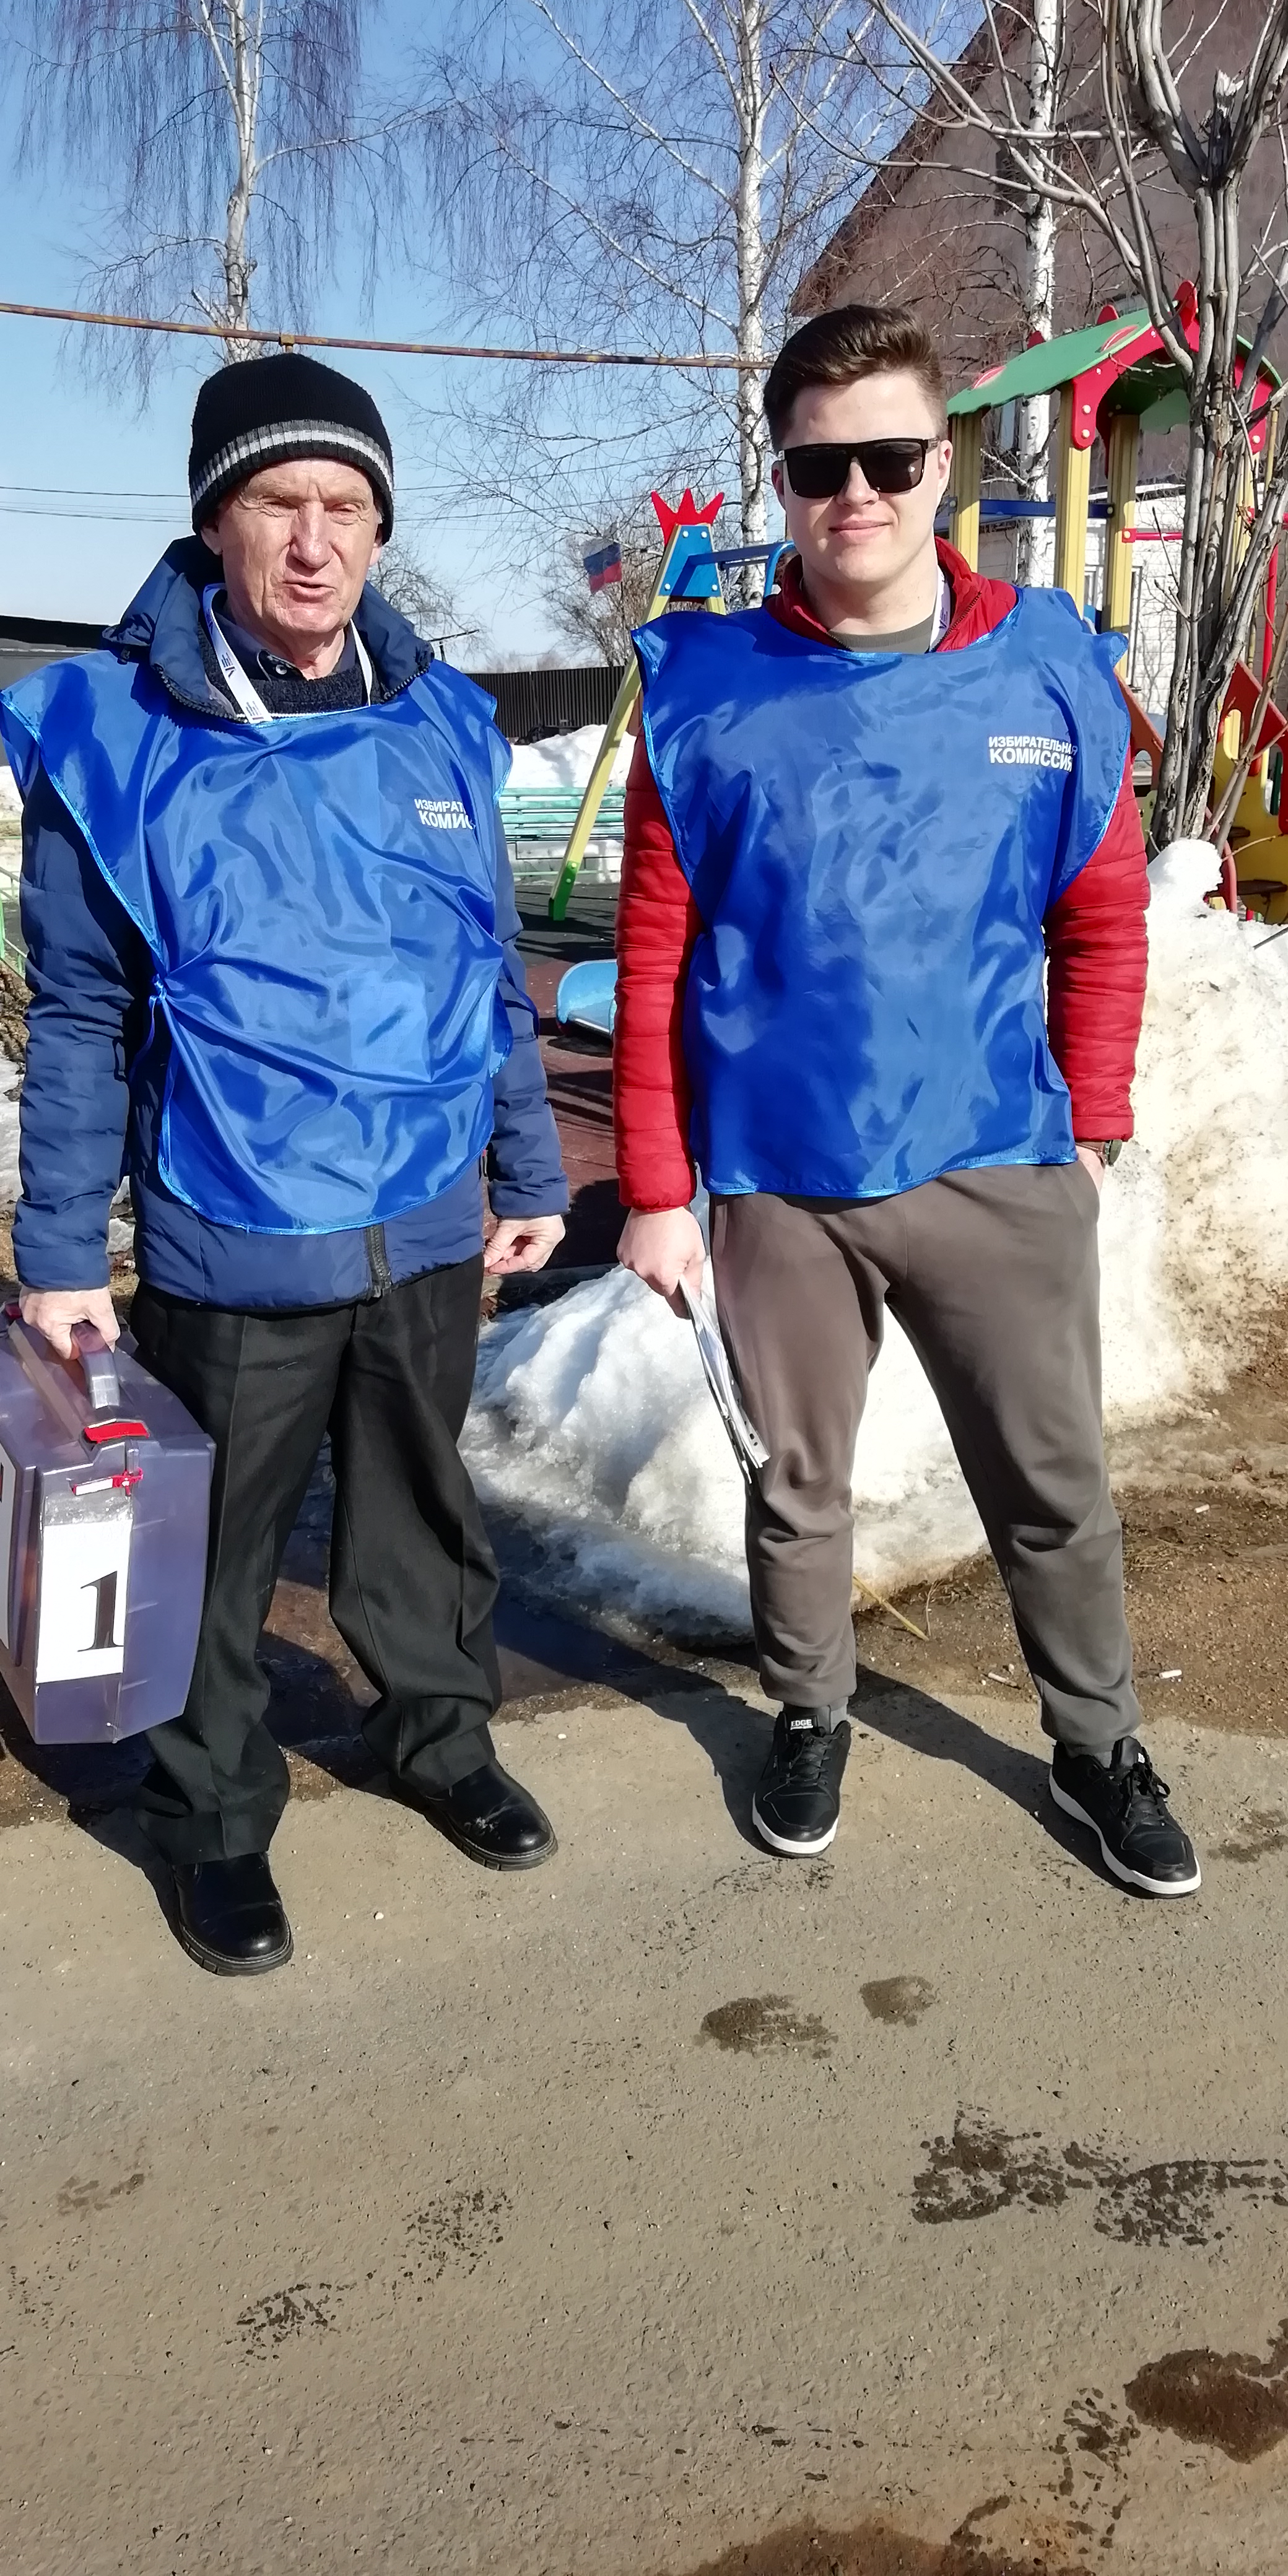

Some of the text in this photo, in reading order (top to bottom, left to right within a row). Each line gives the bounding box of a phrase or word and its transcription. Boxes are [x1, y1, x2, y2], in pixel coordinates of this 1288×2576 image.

[988, 736, 1078, 755] ИЗБИРАТЕЛЬНАЯ
[990, 747, 1073, 772] КОМИССИЯ
[414, 798, 466, 814] ИЗБИРАТ
[77, 1570, 124, 1652] 1
[791, 1718, 812, 1727] EDGE
